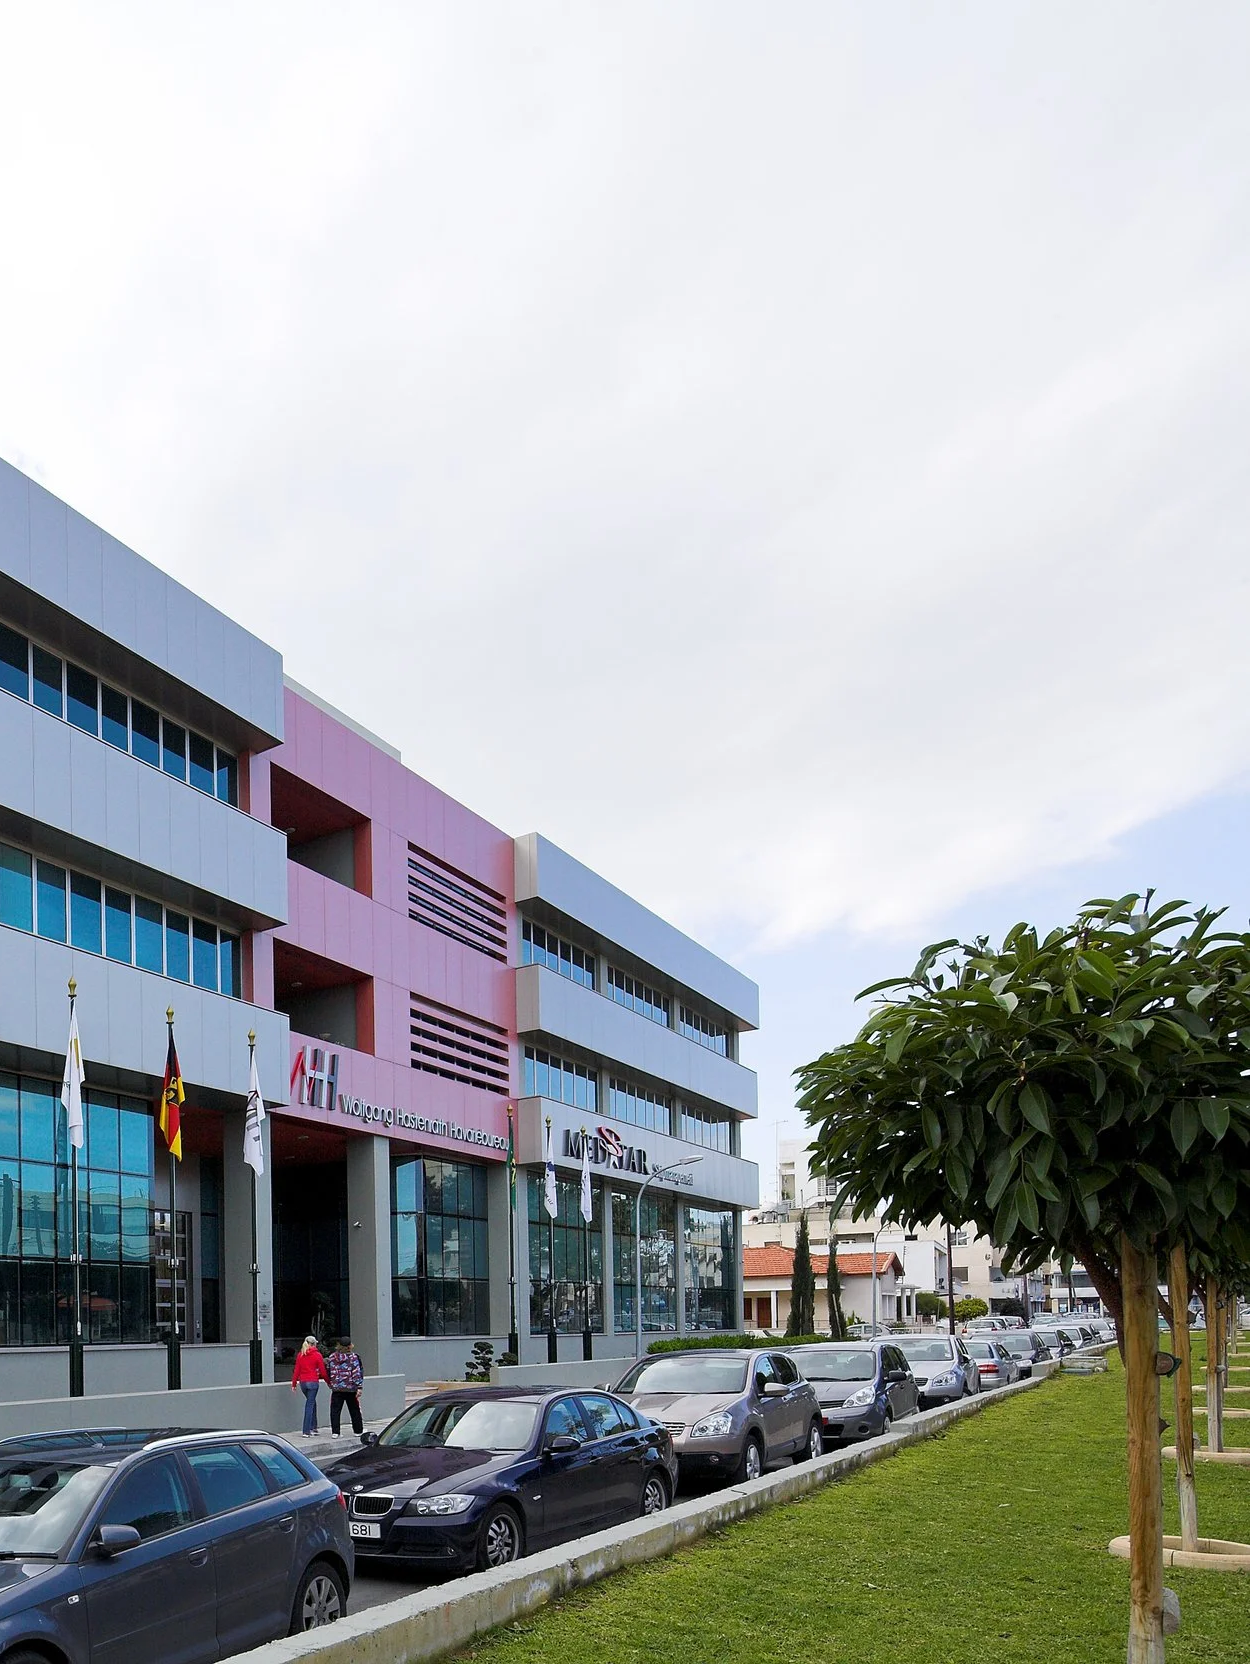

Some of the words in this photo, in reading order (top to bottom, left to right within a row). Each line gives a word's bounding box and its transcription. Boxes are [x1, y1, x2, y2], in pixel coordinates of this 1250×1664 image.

[341, 1093, 394, 1127] Wolfgang
[396, 1107, 448, 1136] Hastenrath
[352, 1523, 371, 1536] 681
